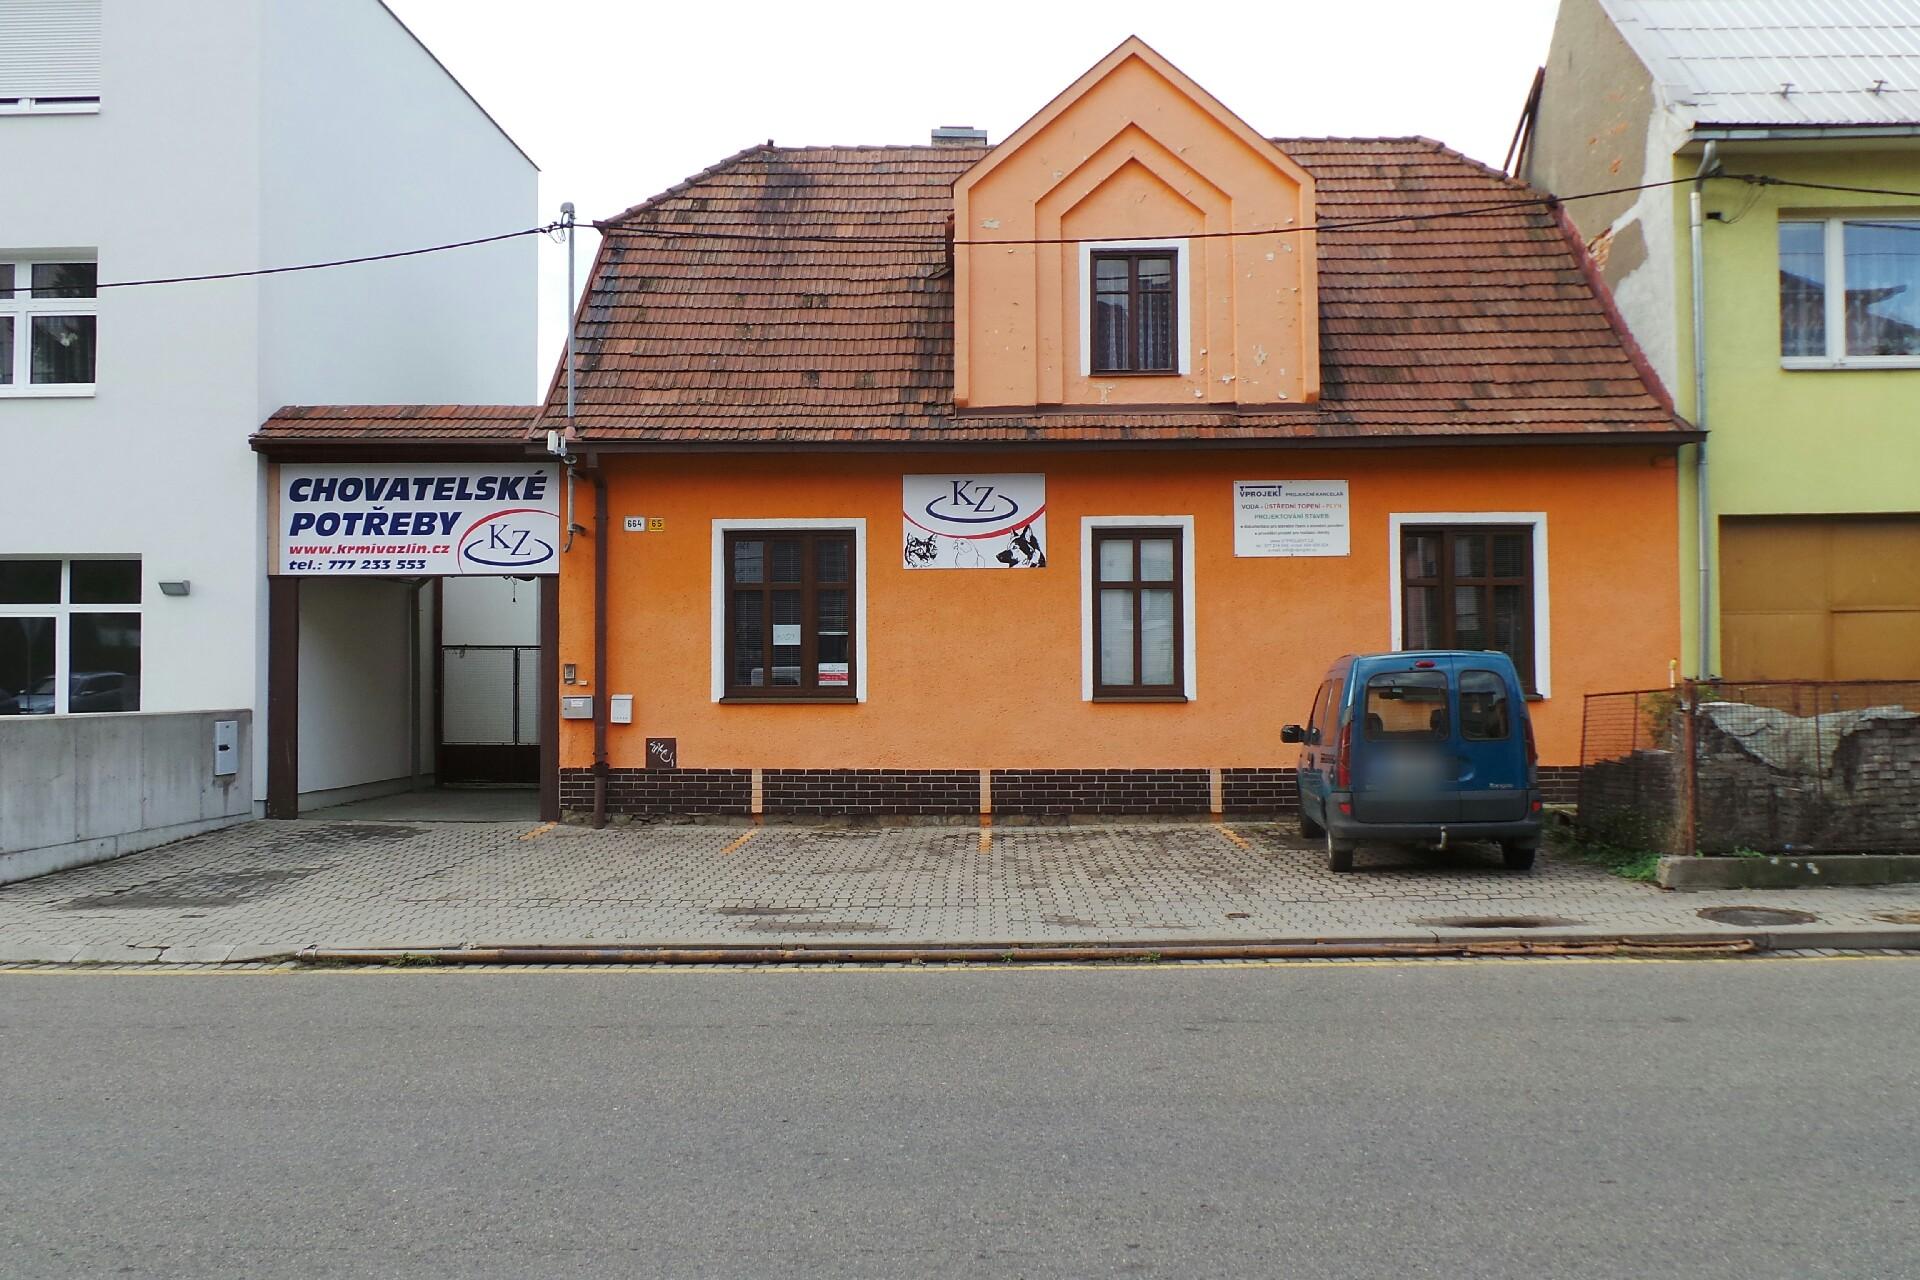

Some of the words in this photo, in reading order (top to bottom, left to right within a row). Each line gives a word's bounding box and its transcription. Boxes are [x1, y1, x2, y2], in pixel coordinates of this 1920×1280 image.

[289, 470, 547, 502] CHOVATELSKÉ
[950, 480, 996, 512] KZ
[289, 506, 462, 536] POTŘEBY
[627, 519, 642, 528] 664
[289, 543, 450, 554] www.krmivazlin.cz
[487, 524, 532, 555] KZ
[289, 559, 322, 570] tel.:
[328, 559, 356, 569] 777
[361, 559, 391, 569] 233
[396, 559, 426, 569] 553
